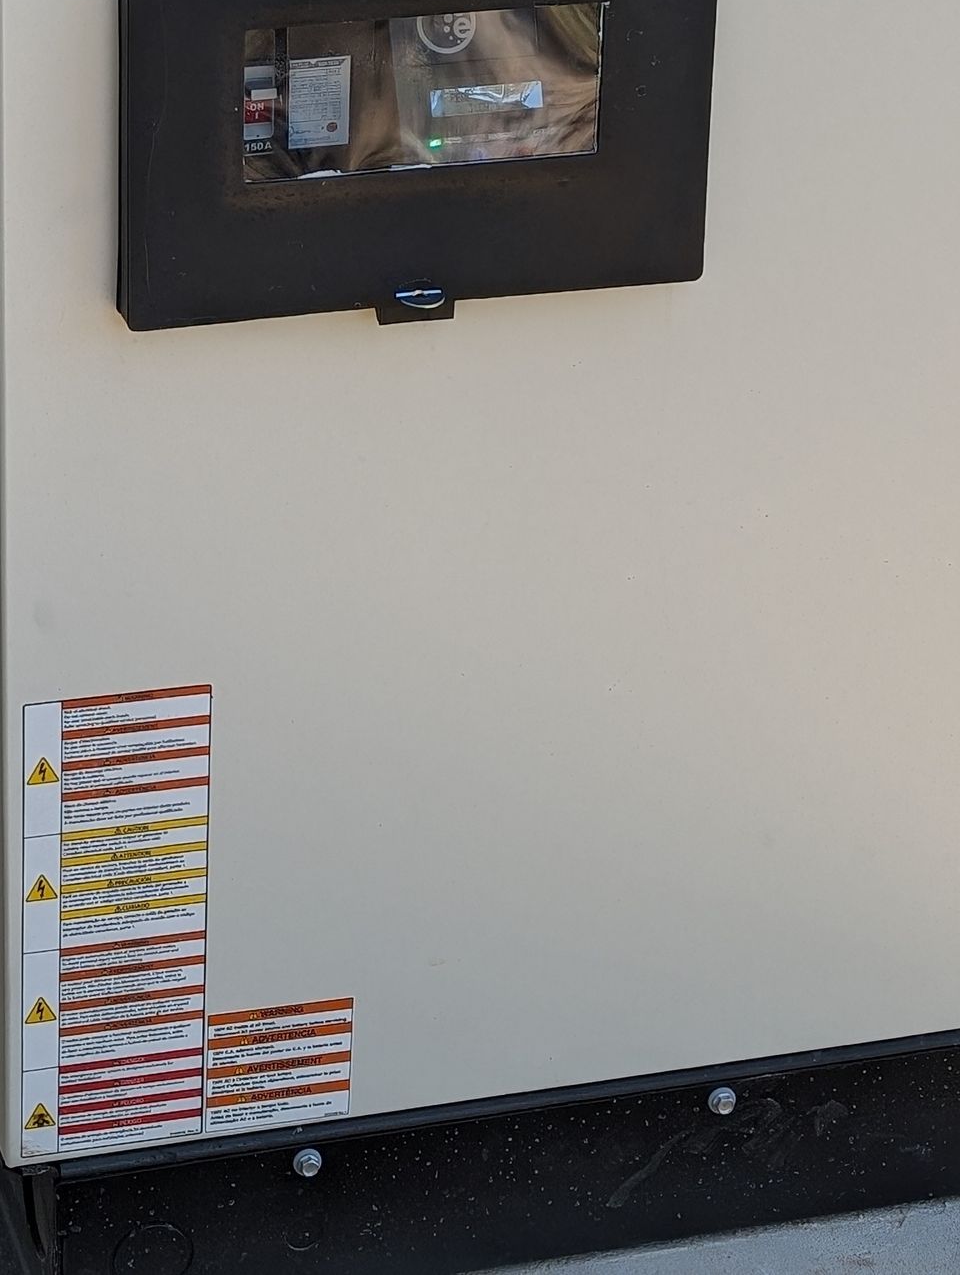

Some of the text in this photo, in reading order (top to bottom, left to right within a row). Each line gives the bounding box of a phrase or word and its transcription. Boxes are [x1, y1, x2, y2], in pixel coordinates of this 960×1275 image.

[244, 141, 273, 152] 150A
[260, 1005, 304, 1018] WARNING
[251, 1028, 317, 1043] ADVERTENCIA
[247, 1056, 322, 1073] AVERTISSEMENT
